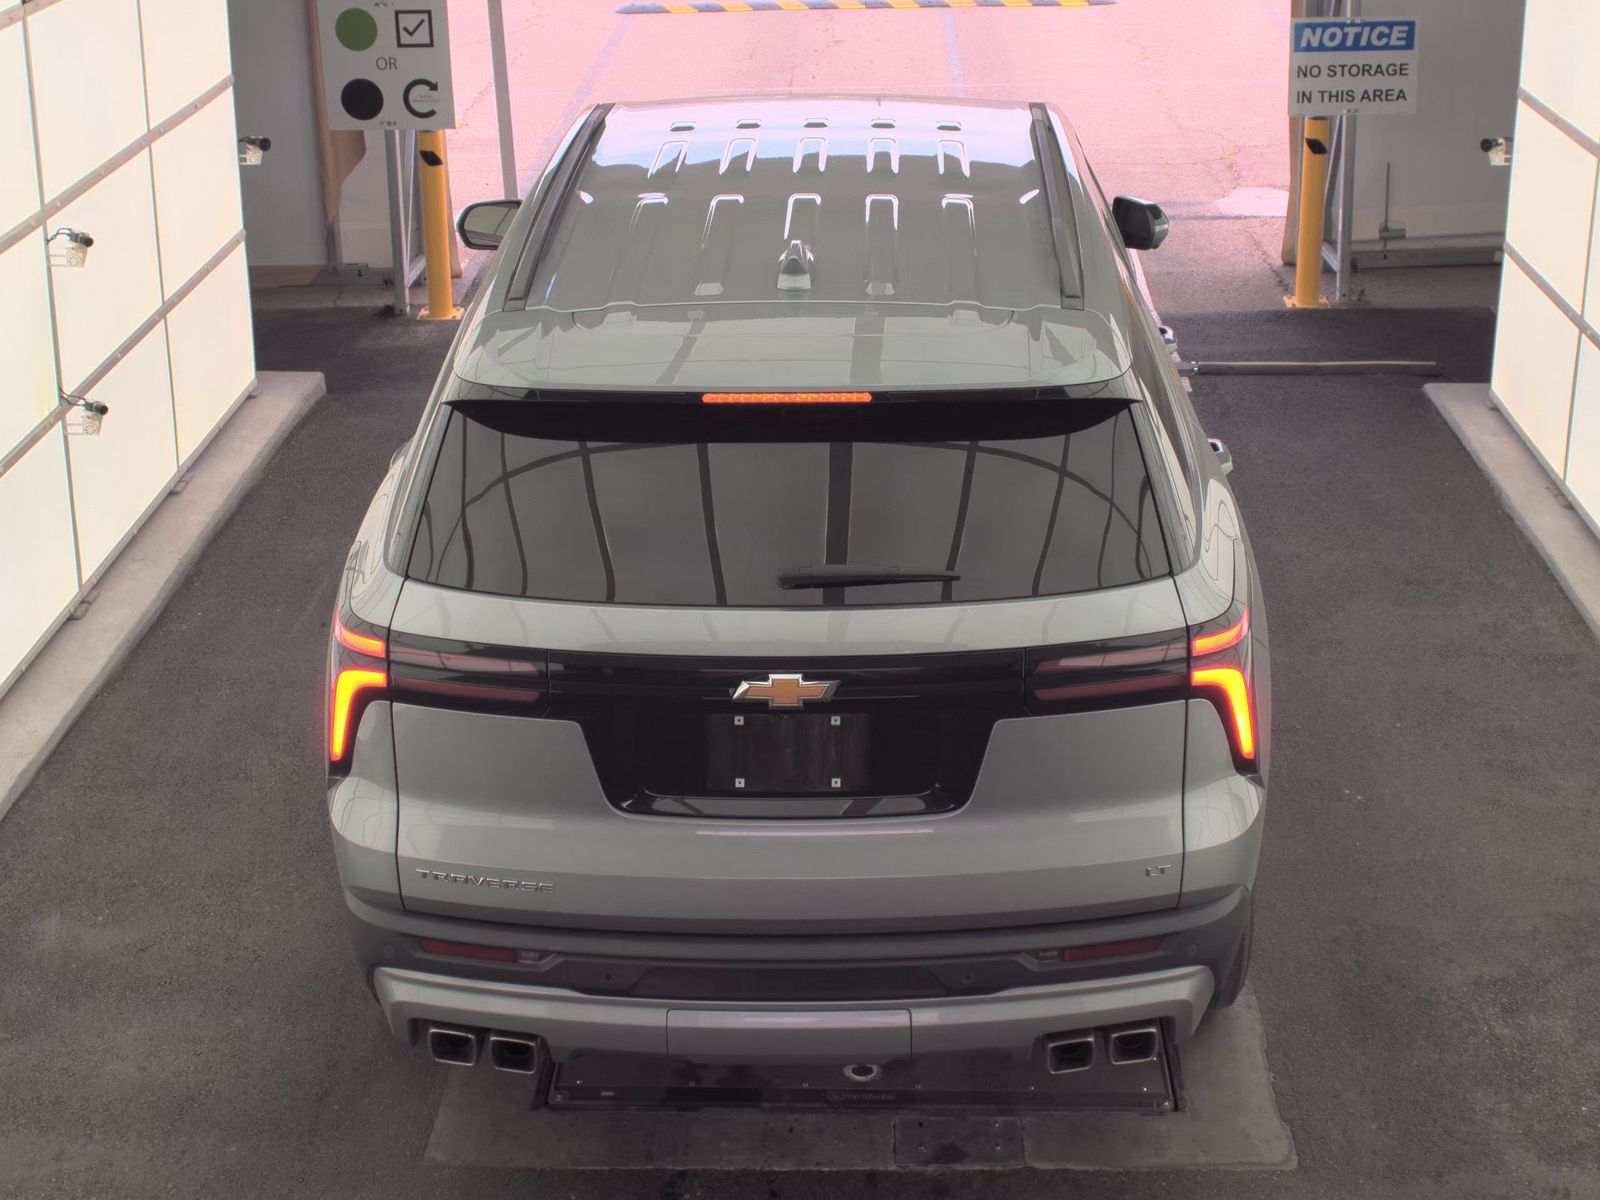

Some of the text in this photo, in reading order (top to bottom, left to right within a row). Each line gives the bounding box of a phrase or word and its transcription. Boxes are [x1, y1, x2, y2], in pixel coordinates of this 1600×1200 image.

[1300, 25, 1409, 48] NOTICE
[375, 56, 398, 71] OR
[1296, 62, 1410, 78] NO STORAGE
[1296, 88, 1408, 104] IN THIS AREA
[1145, 864, 1172, 877] LT
[415, 868, 554, 893] TRAVERSE
